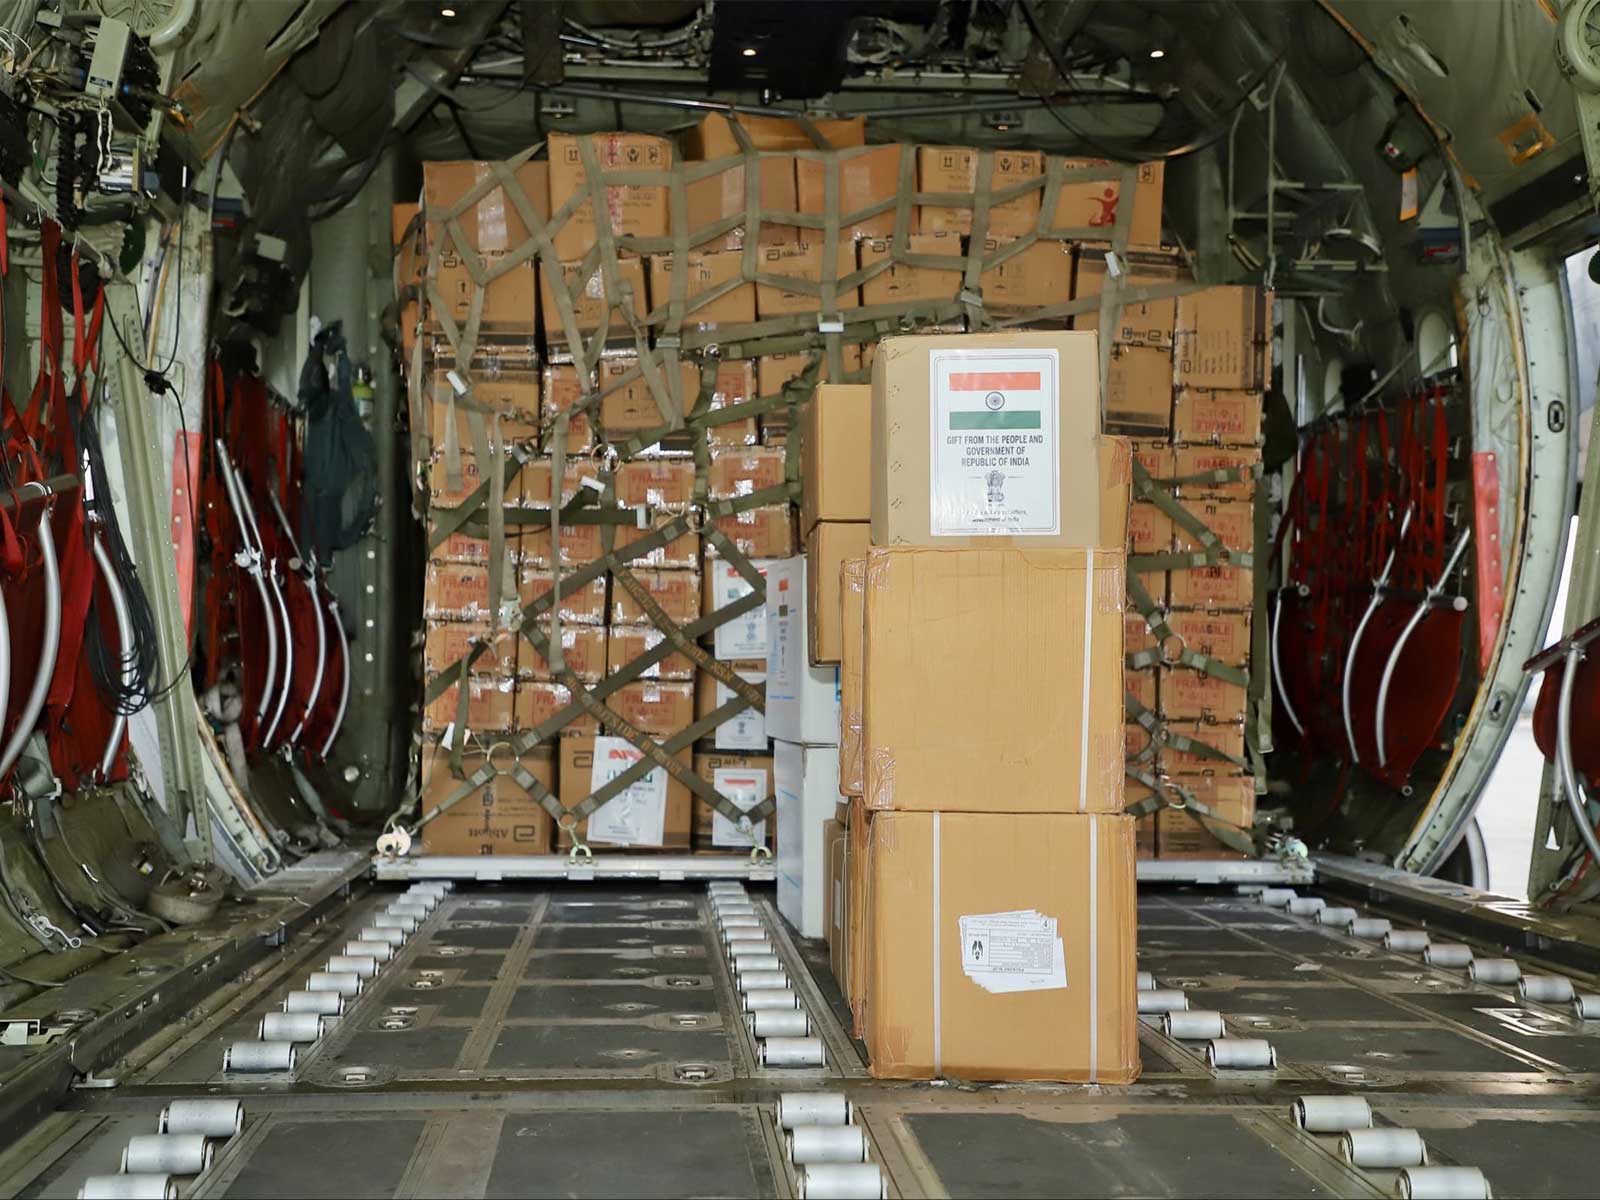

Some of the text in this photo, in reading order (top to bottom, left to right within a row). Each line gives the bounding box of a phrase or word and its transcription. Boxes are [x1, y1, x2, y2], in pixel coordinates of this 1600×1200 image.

[946, 434, 1044, 445] GIFT FROM THE PEOPLE AND
[966, 446, 1026, 456] GOVERNMENT OF
[961, 457, 1030, 467] REPUBLIC OF INDIA
